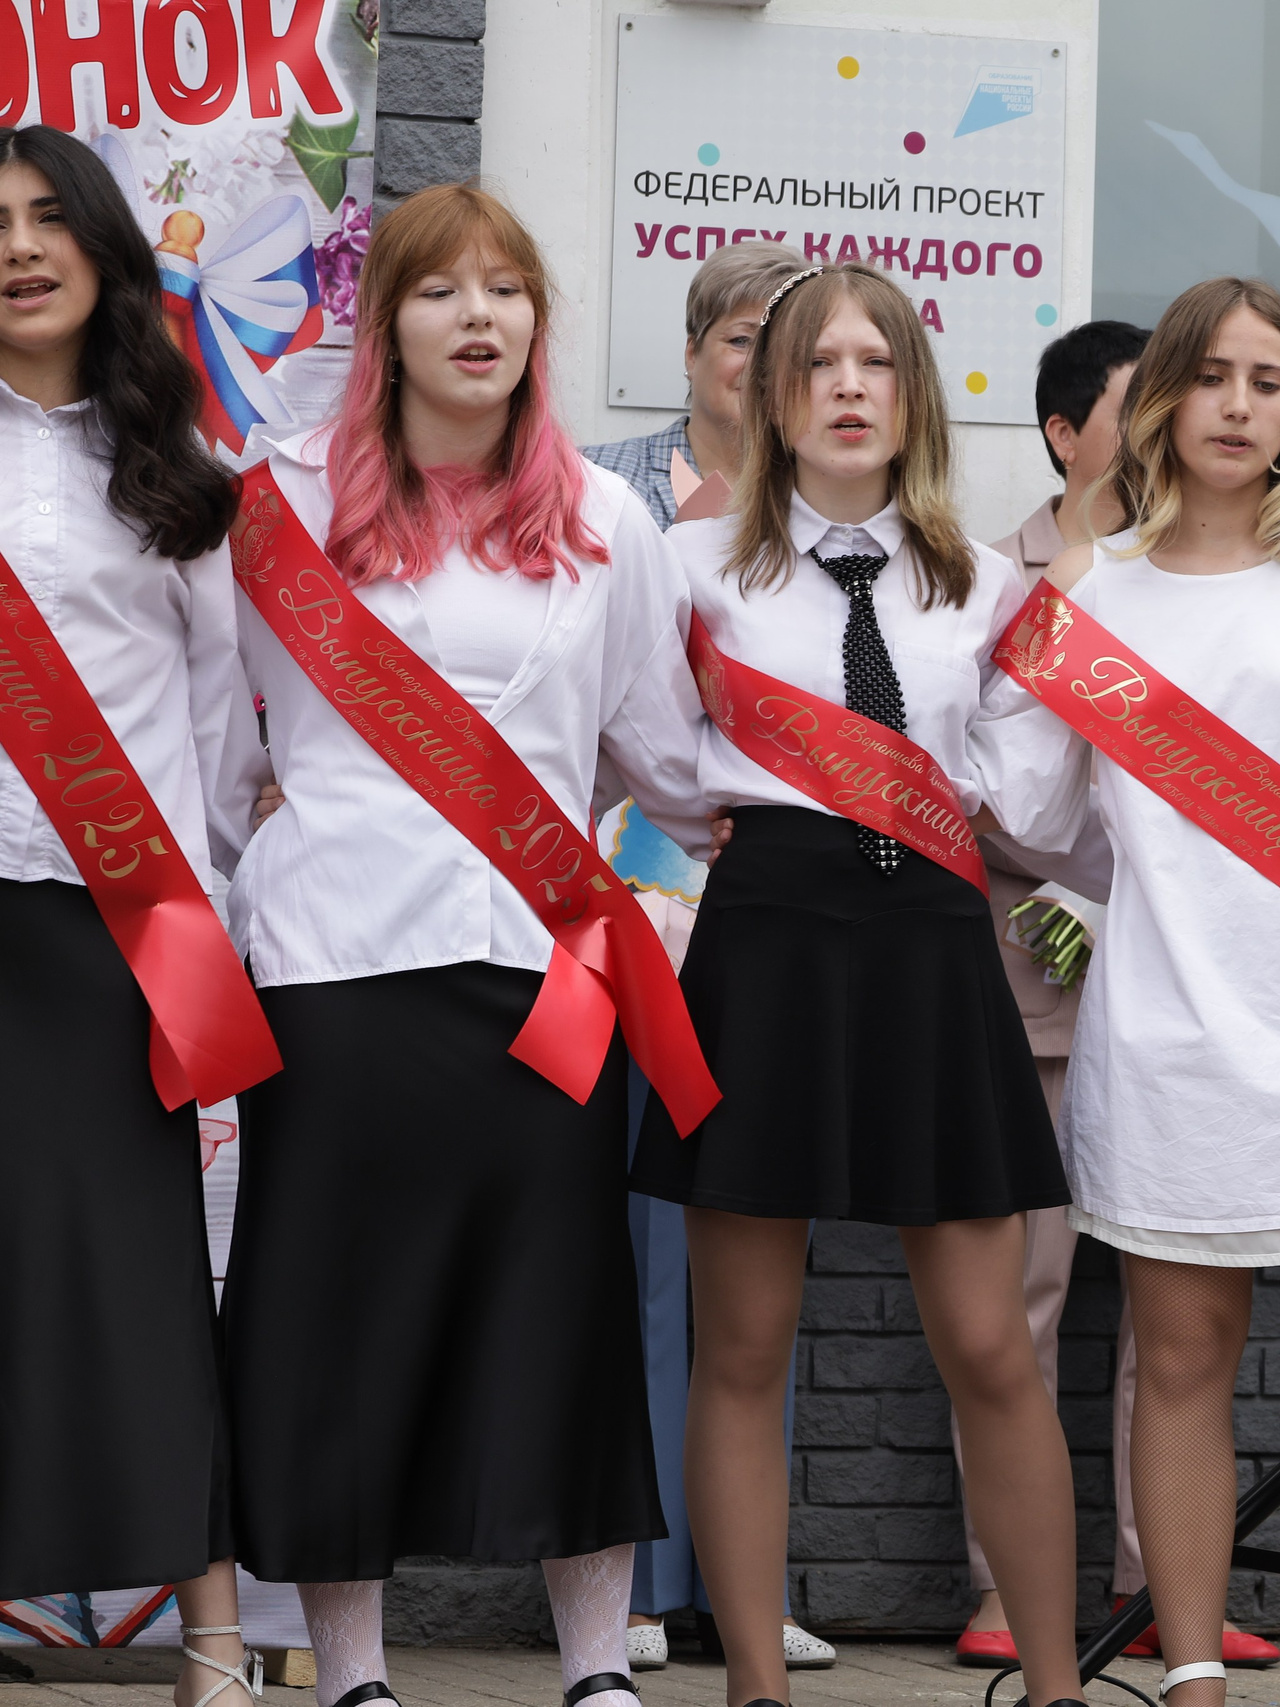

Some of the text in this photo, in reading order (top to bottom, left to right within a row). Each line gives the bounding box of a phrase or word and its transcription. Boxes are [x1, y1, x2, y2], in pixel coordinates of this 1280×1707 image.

[980, 84, 1032, 95] НАЦИОНАЛЬНЫЕ
[1002, 94, 1032, 104] ПРОЕКТЫ
[1007, 103, 1032, 113] РОССИИ
[634, 170, 1045, 218] ФЕДЕРАЛЬНЫЙ ПРОЕКТ
[803, 232, 1043, 281] КАЖДОГО
[15, 621, 60, 681] Лейла
[285, 633, 296, 642] 9
[344, 709, 380, 740] МБОУ
[278, 568, 613, 926] Выпускница 2025
[443, 706, 494, 759] Дарья
[837, 718, 924, 774] Воронцова
[1168, 701, 1238, 763] Блохина
[33, 733, 169, 878] 2025
[1155, 781, 1195, 810] МБОУ
